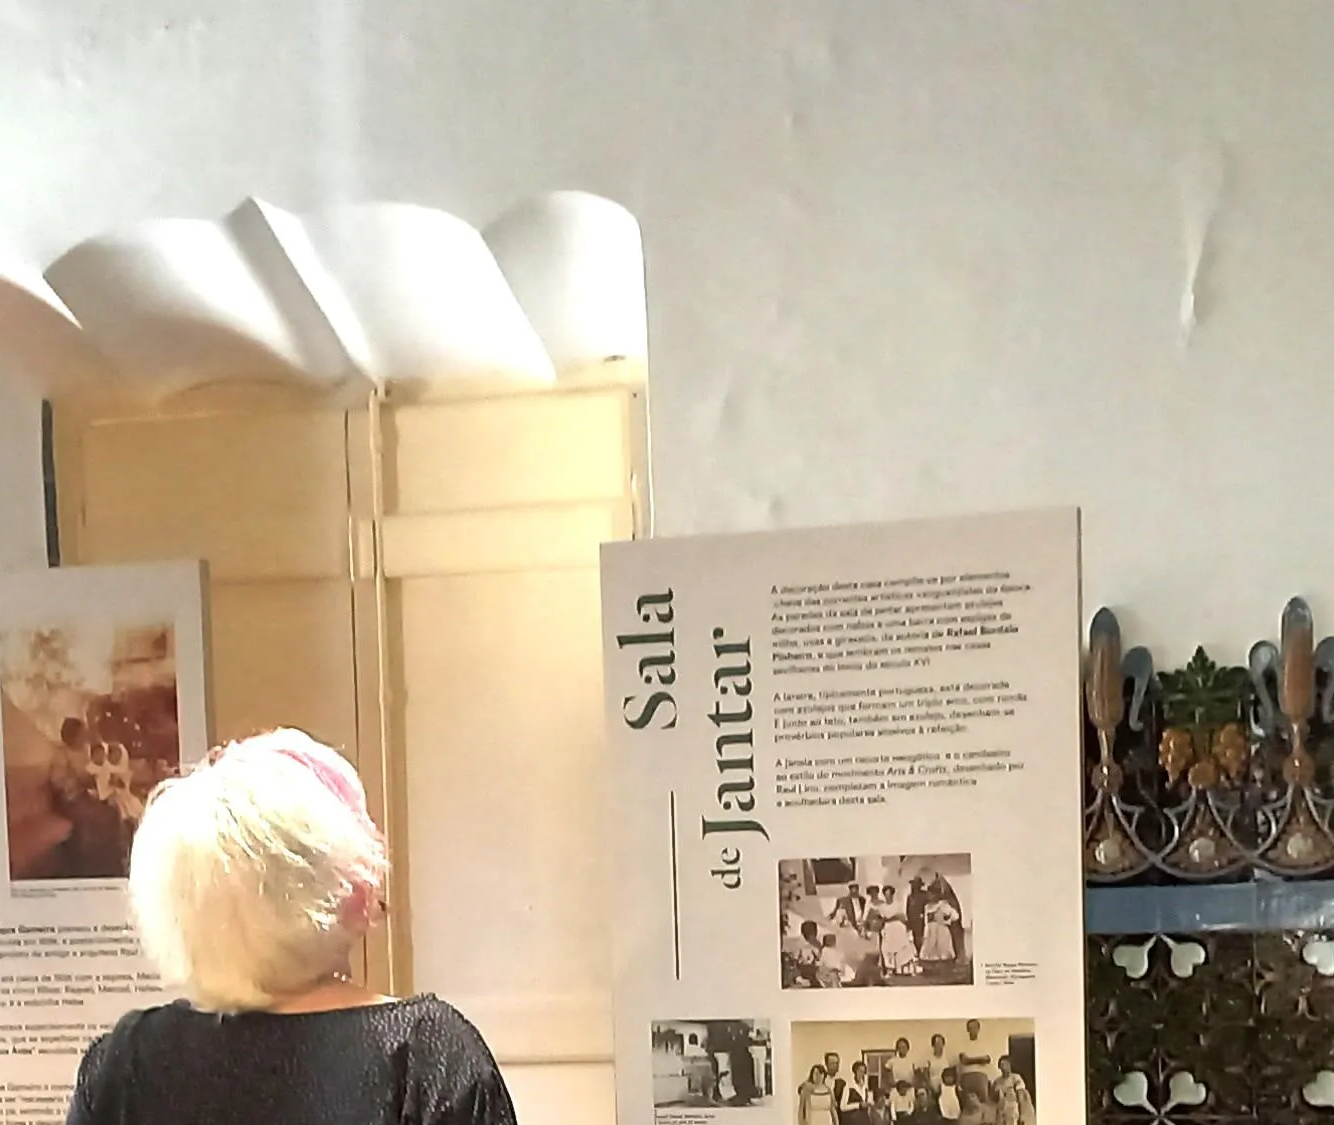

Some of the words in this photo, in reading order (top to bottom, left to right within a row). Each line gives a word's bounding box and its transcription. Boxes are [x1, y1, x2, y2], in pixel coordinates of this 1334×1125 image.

[616, 586, 678, 731] Sala
[701, 626, 770, 843] Jantar
[710, 847, 741, 889] de
